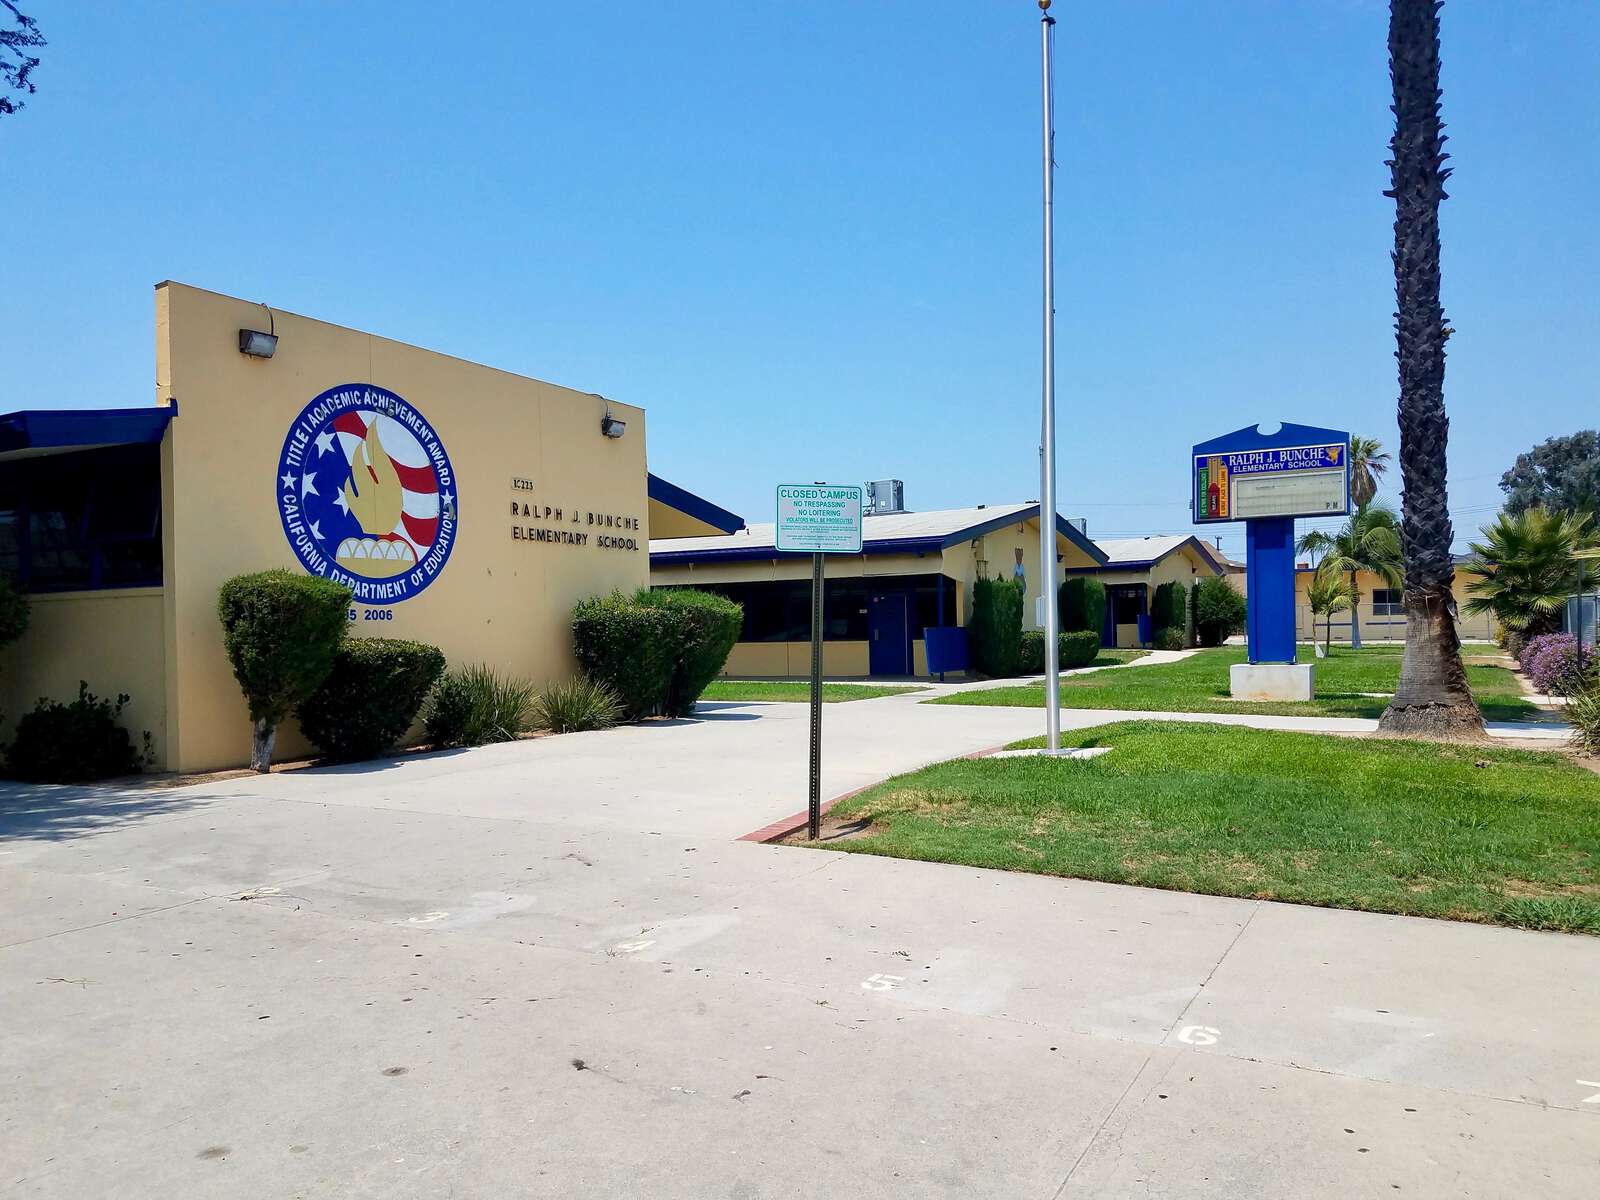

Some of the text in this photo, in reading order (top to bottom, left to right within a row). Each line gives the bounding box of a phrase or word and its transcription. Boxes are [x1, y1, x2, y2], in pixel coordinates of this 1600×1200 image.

[286, 428, 309, 467] TITLE
[307, 390, 361, 428] ACADEMIC
[364, 391, 433, 442] ACHIEVEMENT
[427, 441, 451, 486] AWARD
[1229, 447, 1325, 466] RALPH J. BUNCHE
[1233, 459, 1322, 473] ELEMENTARY SCHOOL
[781, 489, 858, 500] CLOSED CAMPUS
[512, 502, 563, 521] RALPH
[587, 512, 639, 531] BUNCHE
[283, 494, 454, 600] CALIFORNIA DEPARTMENT OF EDUCATION
[512, 526, 639, 552] ELEMENTARY SCHOOL
[363, 609, 393, 621] 2006
[860, 973, 905, 991] 5
[1178, 1025, 1222, 1046] 6
